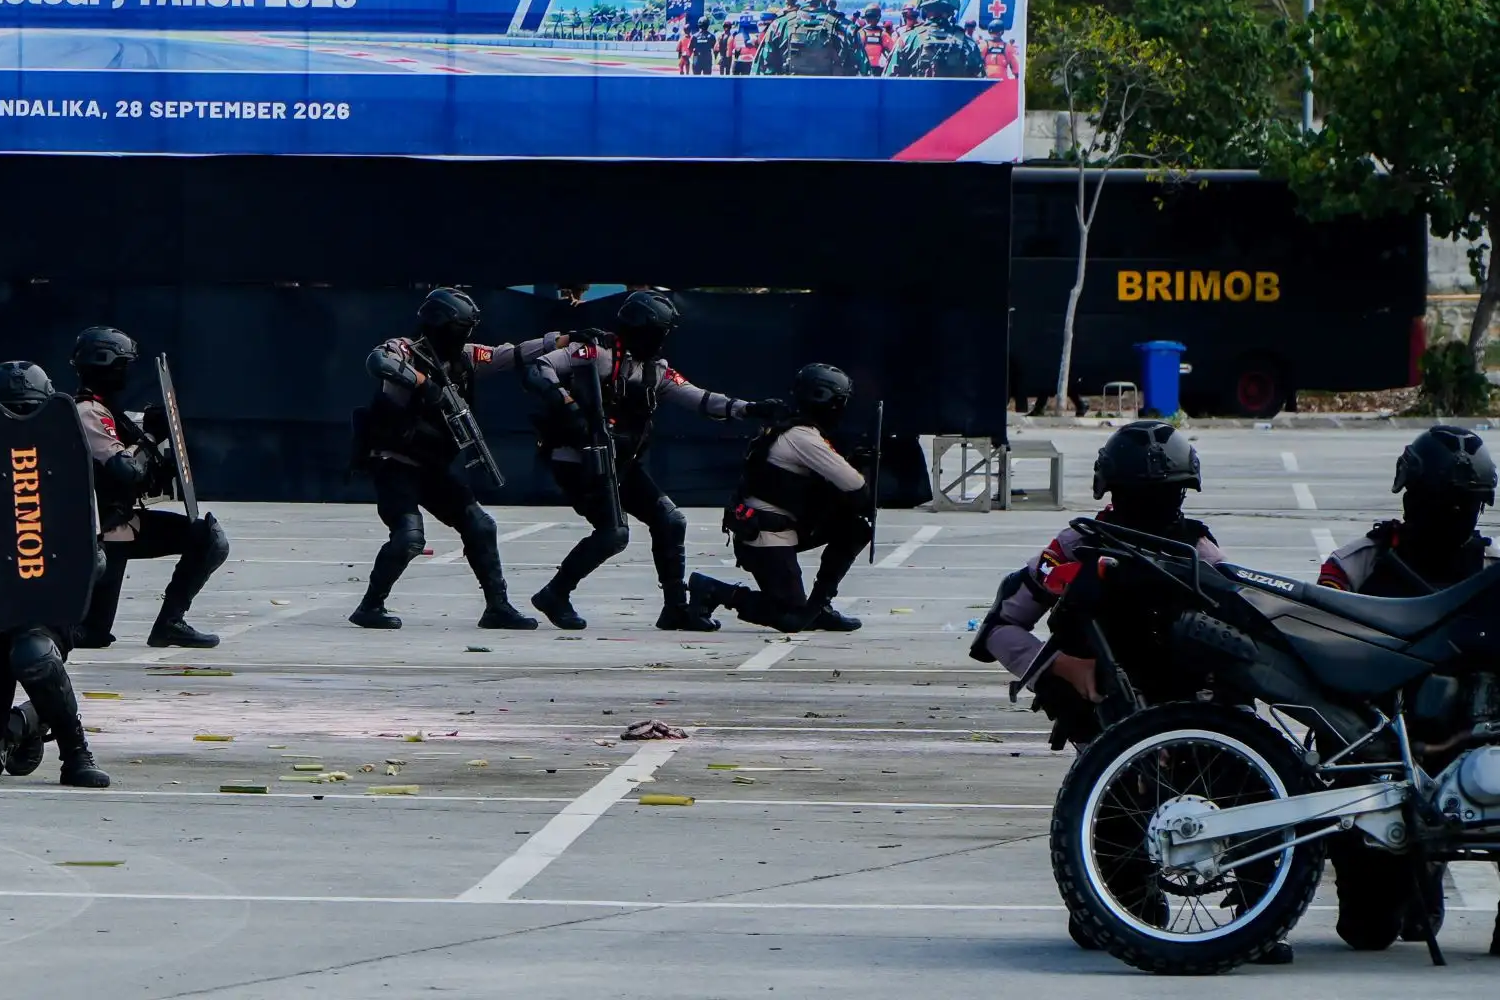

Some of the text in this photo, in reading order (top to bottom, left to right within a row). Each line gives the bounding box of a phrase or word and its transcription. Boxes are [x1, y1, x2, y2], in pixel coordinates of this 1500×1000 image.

[115, 101, 143, 118] 28
[150, 100, 286, 119] SEPTEMBER
[293, 102, 350, 120] 2026
[1117, 270, 1281, 302] BRIMOB
[11, 447, 44, 579] BRIMOB
[1235, 568, 1295, 592] SUZUKI
